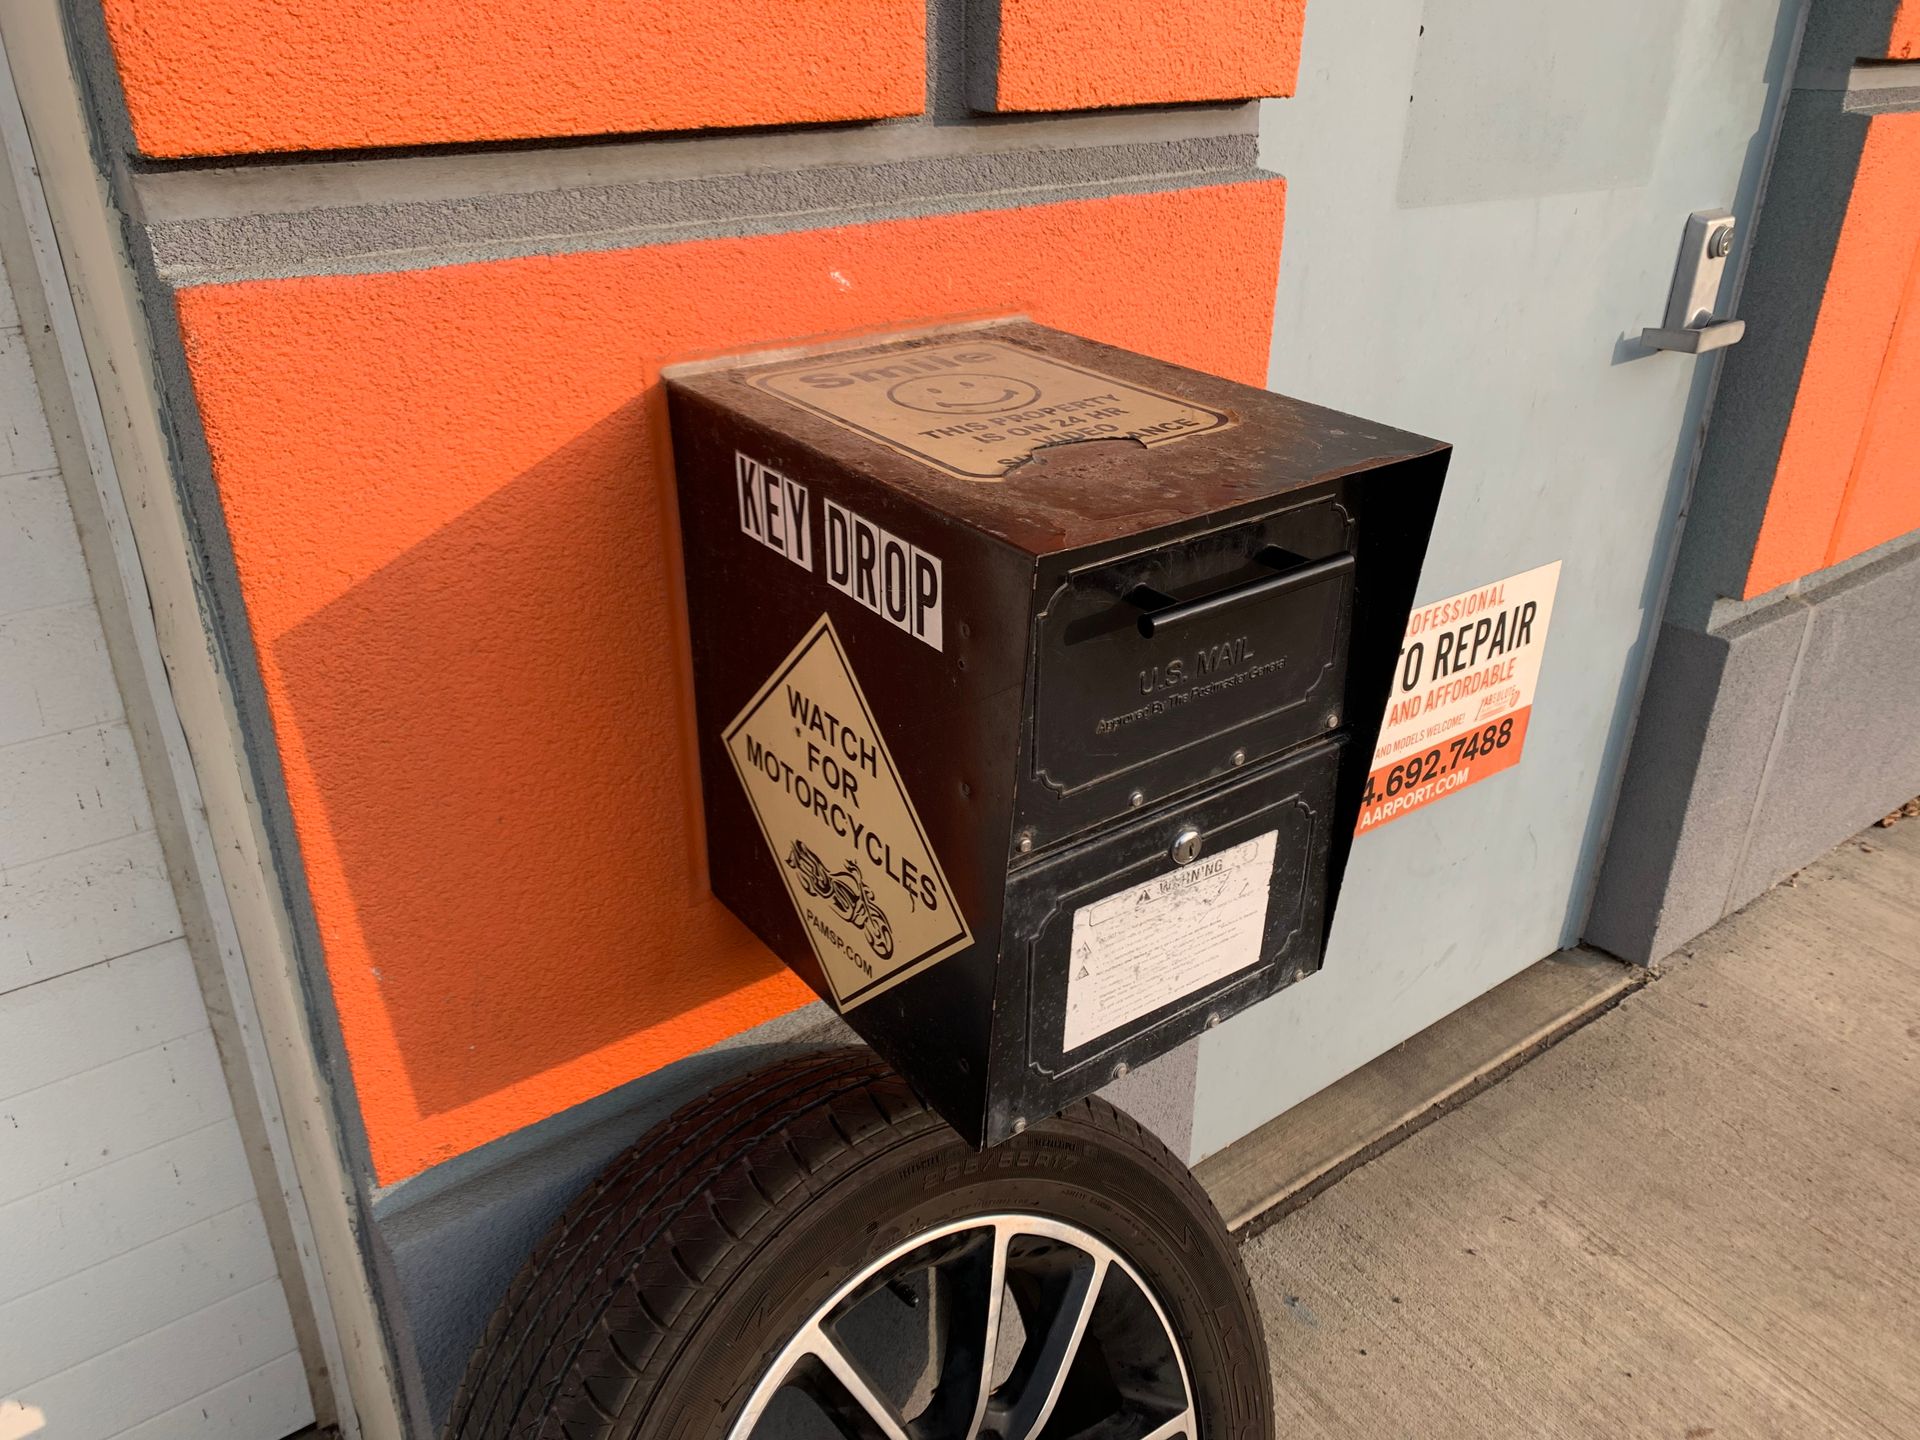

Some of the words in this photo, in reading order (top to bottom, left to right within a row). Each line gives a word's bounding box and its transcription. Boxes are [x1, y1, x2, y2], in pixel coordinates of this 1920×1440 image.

[799, 352, 996, 389] Smile
[918, 421, 988, 441] THIS
[988, 393, 1121, 426] PROPERTY
[971, 431, 1001, 445] IS
[1007, 423, 1052, 437] ON
[1049, 413, 1087, 428] 24
[1089, 405, 1131, 421] HR
[1031, 423, 1120, 446] VIDEO
[739, 455, 806, 563] KEY
[828, 504, 938, 638] DROP
[1404, 583, 1505, 637] OFESSIONAL
[1138, 658, 1189, 696] U.S.
[1195, 636, 1255, 679] MAIL
[1400, 641, 1424, 692] O
[1432, 600, 1538, 682] REPAIR
[1096, 703, 1151, 735] Approved
[1150, 698, 1168, 715] By
[1168, 692, 1190, 710] The
[1190, 671, 1248, 700] Postmaster
[1249, 655, 1289, 680] General
[1388, 695, 1422, 729] AND
[1423, 656, 1518, 716] AFFORDABLE
[786, 683, 877, 779] WATCH
[1375, 743, 1392, 760] AND
[1393, 729, 1426, 753] MODELS
[807, 740, 860, 809] FOR
[1360, 767, 1471, 829] AARPORT.COM
[746, 733, 938, 911] MOTORCYCLES
[806, 908, 873, 979] PAMSP.COM
